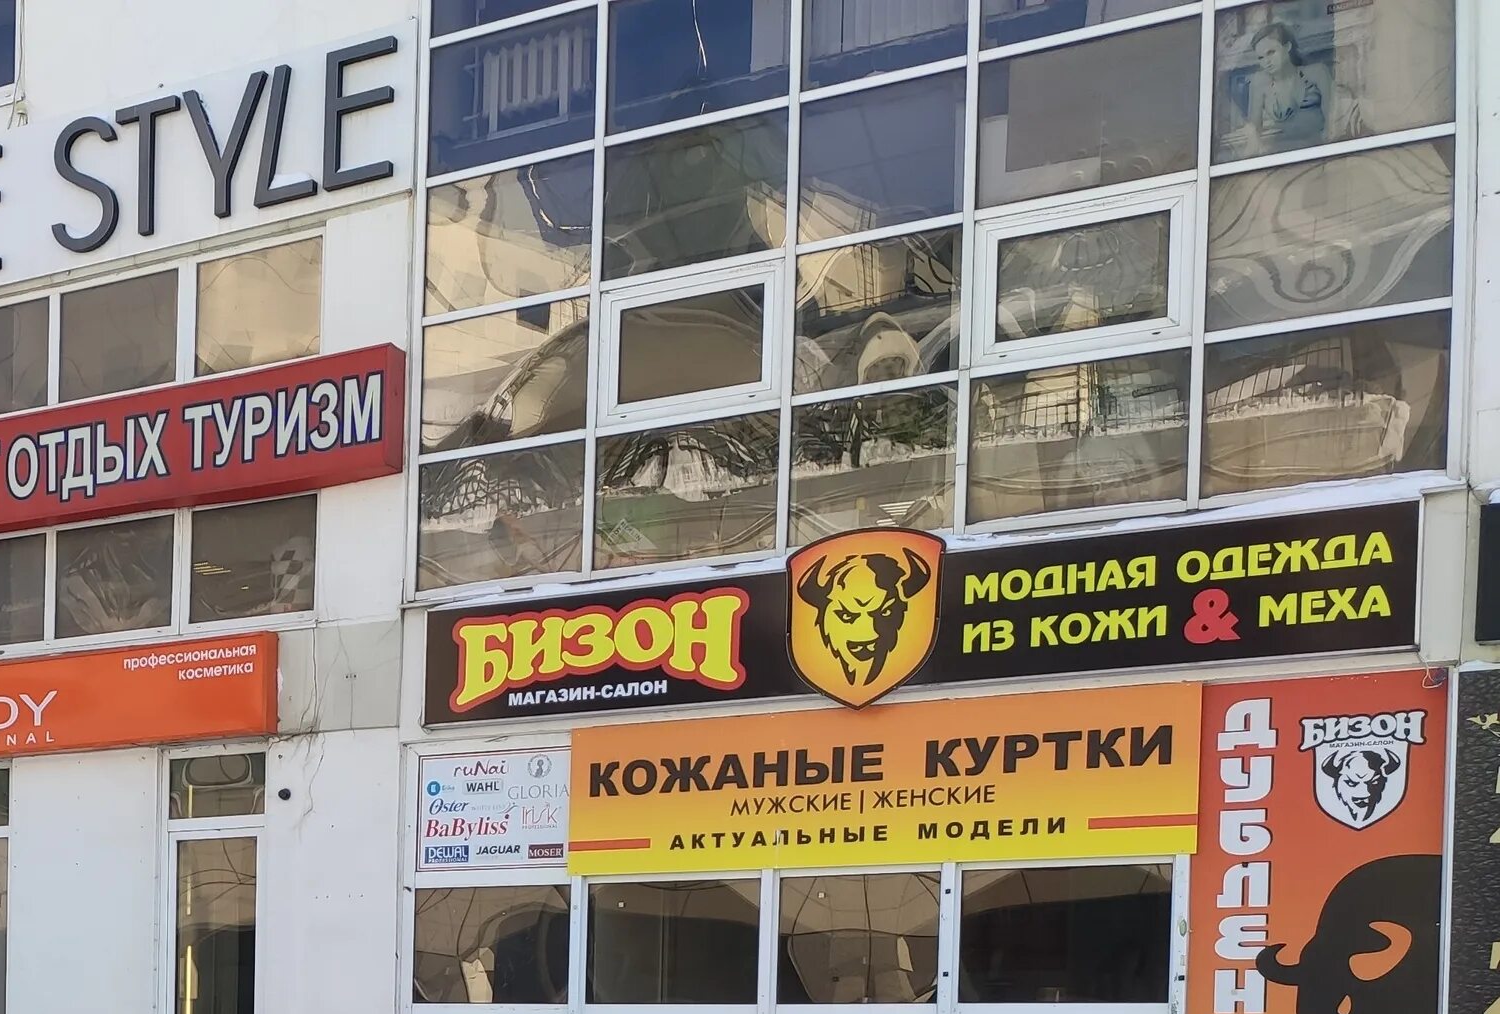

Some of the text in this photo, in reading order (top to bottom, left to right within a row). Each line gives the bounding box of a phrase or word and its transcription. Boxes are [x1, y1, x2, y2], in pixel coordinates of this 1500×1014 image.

[52, 35, 398, 253] STYLE
[7, 411, 169, 501] ОТДЫХ
[183, 372, 383, 468] ТУРИЗМ
[963, 531, 1393, 605] МОДНАЯ ОДЕЖДА
[962, 584, 1391, 654] ИЗ КОЖИ & МЕХА
[123, 642, 258, 672] профессиональная
[455, 594, 743, 707] БИЗОН
[177, 660, 255, 682] косметика
[508, 679, 668, 707] МАГАЗИН-САЛОН
[1299, 710, 1426, 750] БИЗОН
[1329, 740, 1394, 748] МАГАЗИН-САЛОН
[589, 743, 885, 797] КОЖАНЫЕ
[924, 725, 1174, 778] КУРТКИ
[466, 781, 500, 792] WAHL
[508, 784, 570, 800] GLORIA
[730, 783, 996, 817] МУЖСКИЕ ЖЕНСКИЕ
[430, 798, 468, 815] Oster
[425, 815, 510, 841] BaByliss
[669, 816, 1067, 851] АКТУАЛЬНЫЕ МОДЕЛИ
[428, 847, 468, 858] DEWAL
[476, 845, 521, 855] JAGUAR
[529, 848, 562, 857] MOSER
